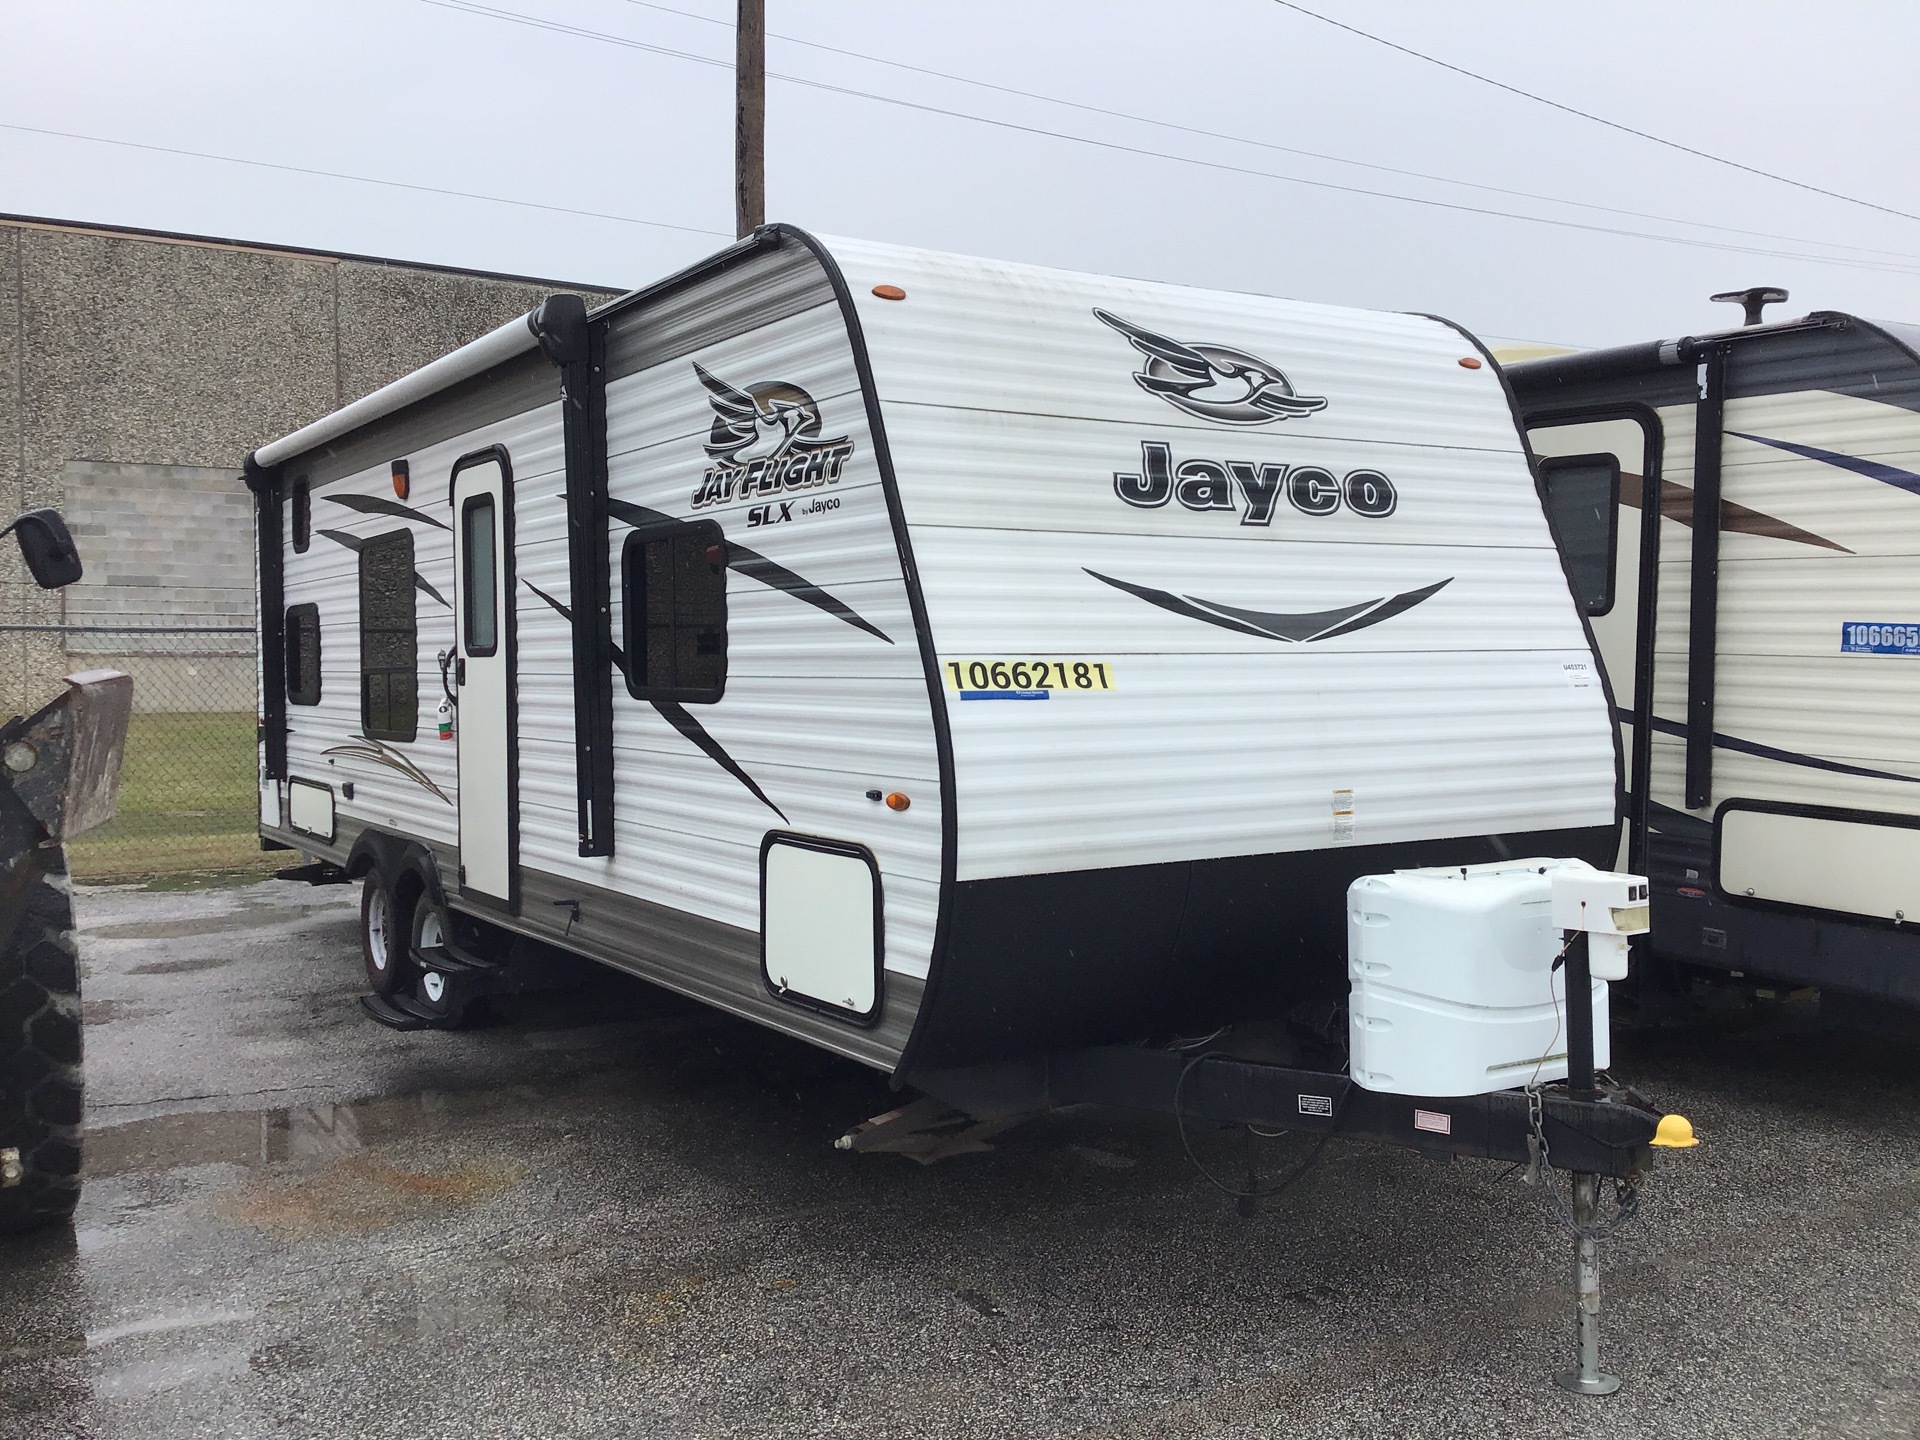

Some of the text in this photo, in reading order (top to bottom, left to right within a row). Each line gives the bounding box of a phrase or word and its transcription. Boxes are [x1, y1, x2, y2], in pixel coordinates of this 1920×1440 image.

[691, 441, 854, 509] JAY FLIGHT
[1113, 440, 1397, 526] Jayco
[747, 498, 840, 528] SLX by Jayco
[1847, 625, 1920, 648] 106665
[948, 662, 1108, 689] 10662181
